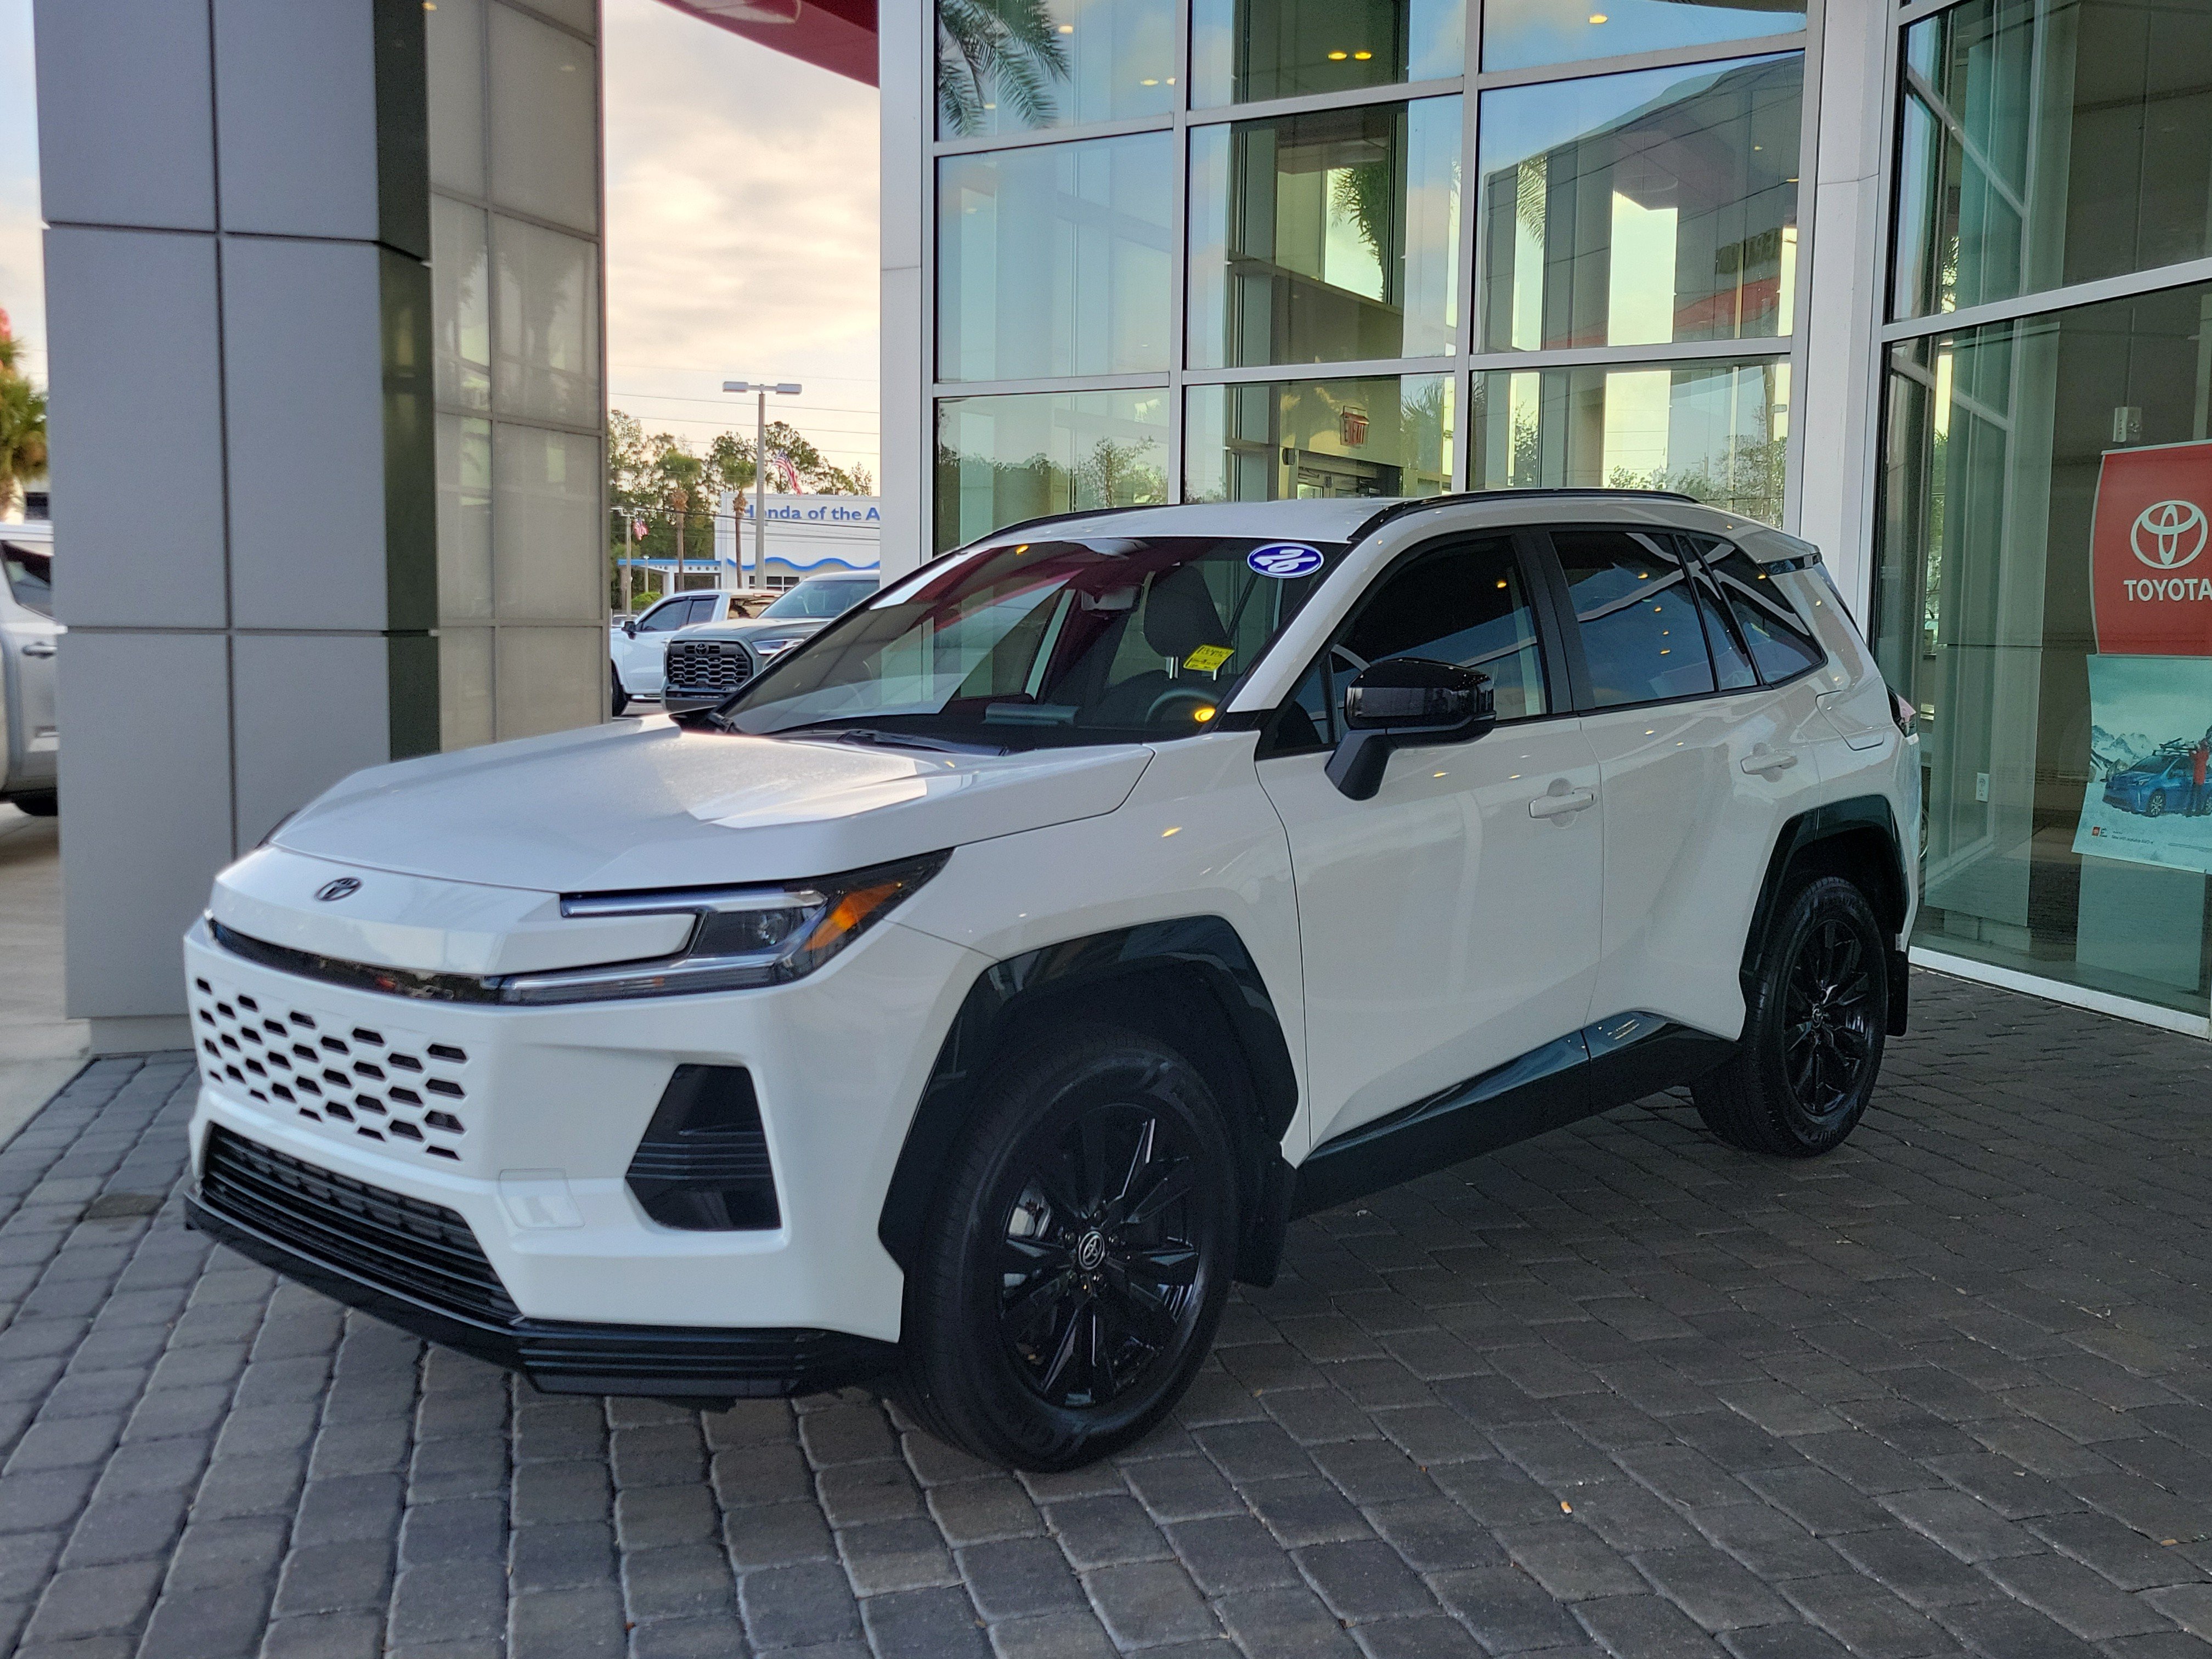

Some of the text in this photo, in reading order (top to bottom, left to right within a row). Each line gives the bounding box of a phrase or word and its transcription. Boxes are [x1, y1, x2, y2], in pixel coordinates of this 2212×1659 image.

[744, 505, 801, 519] Hnda
[808, 506, 827, 520] of
[831, 507, 861, 520] the
[1254, 549, 1317, 572] 26
[2123, 578, 2212, 602] TOYOTA
